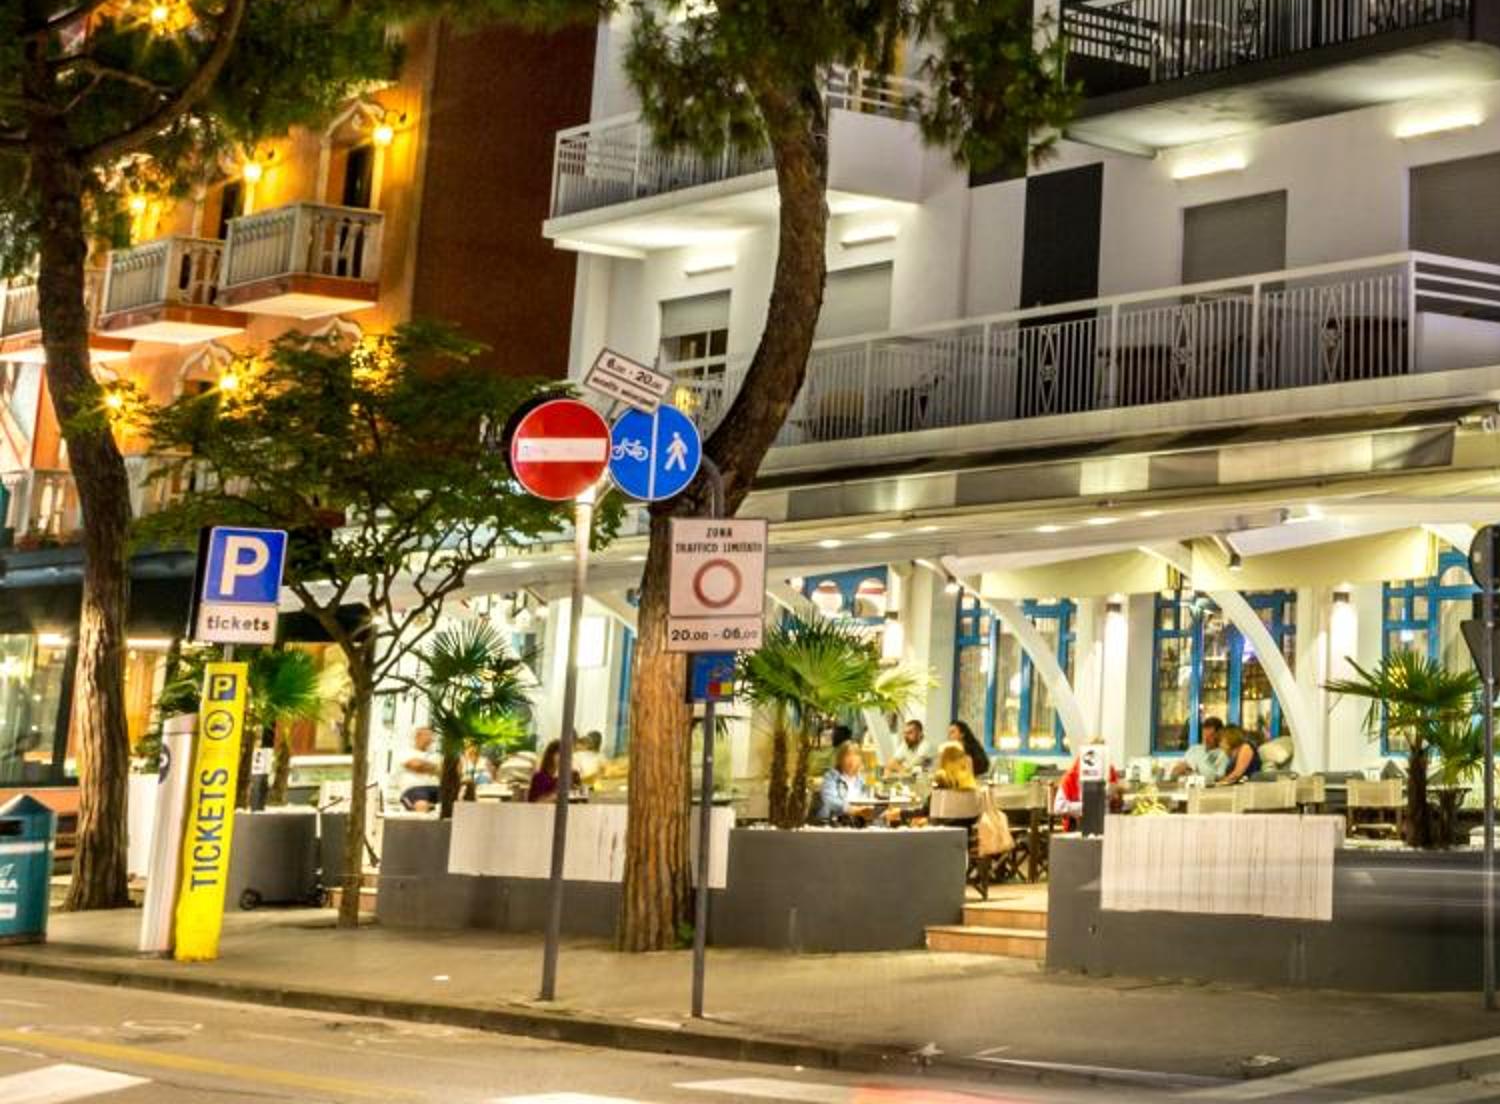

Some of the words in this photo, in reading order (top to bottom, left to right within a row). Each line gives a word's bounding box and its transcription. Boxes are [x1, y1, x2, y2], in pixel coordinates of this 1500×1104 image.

[219, 536, 270, 596] P
[206, 615, 270, 631] tickets
[190, 768, 229, 891] TICKETS
